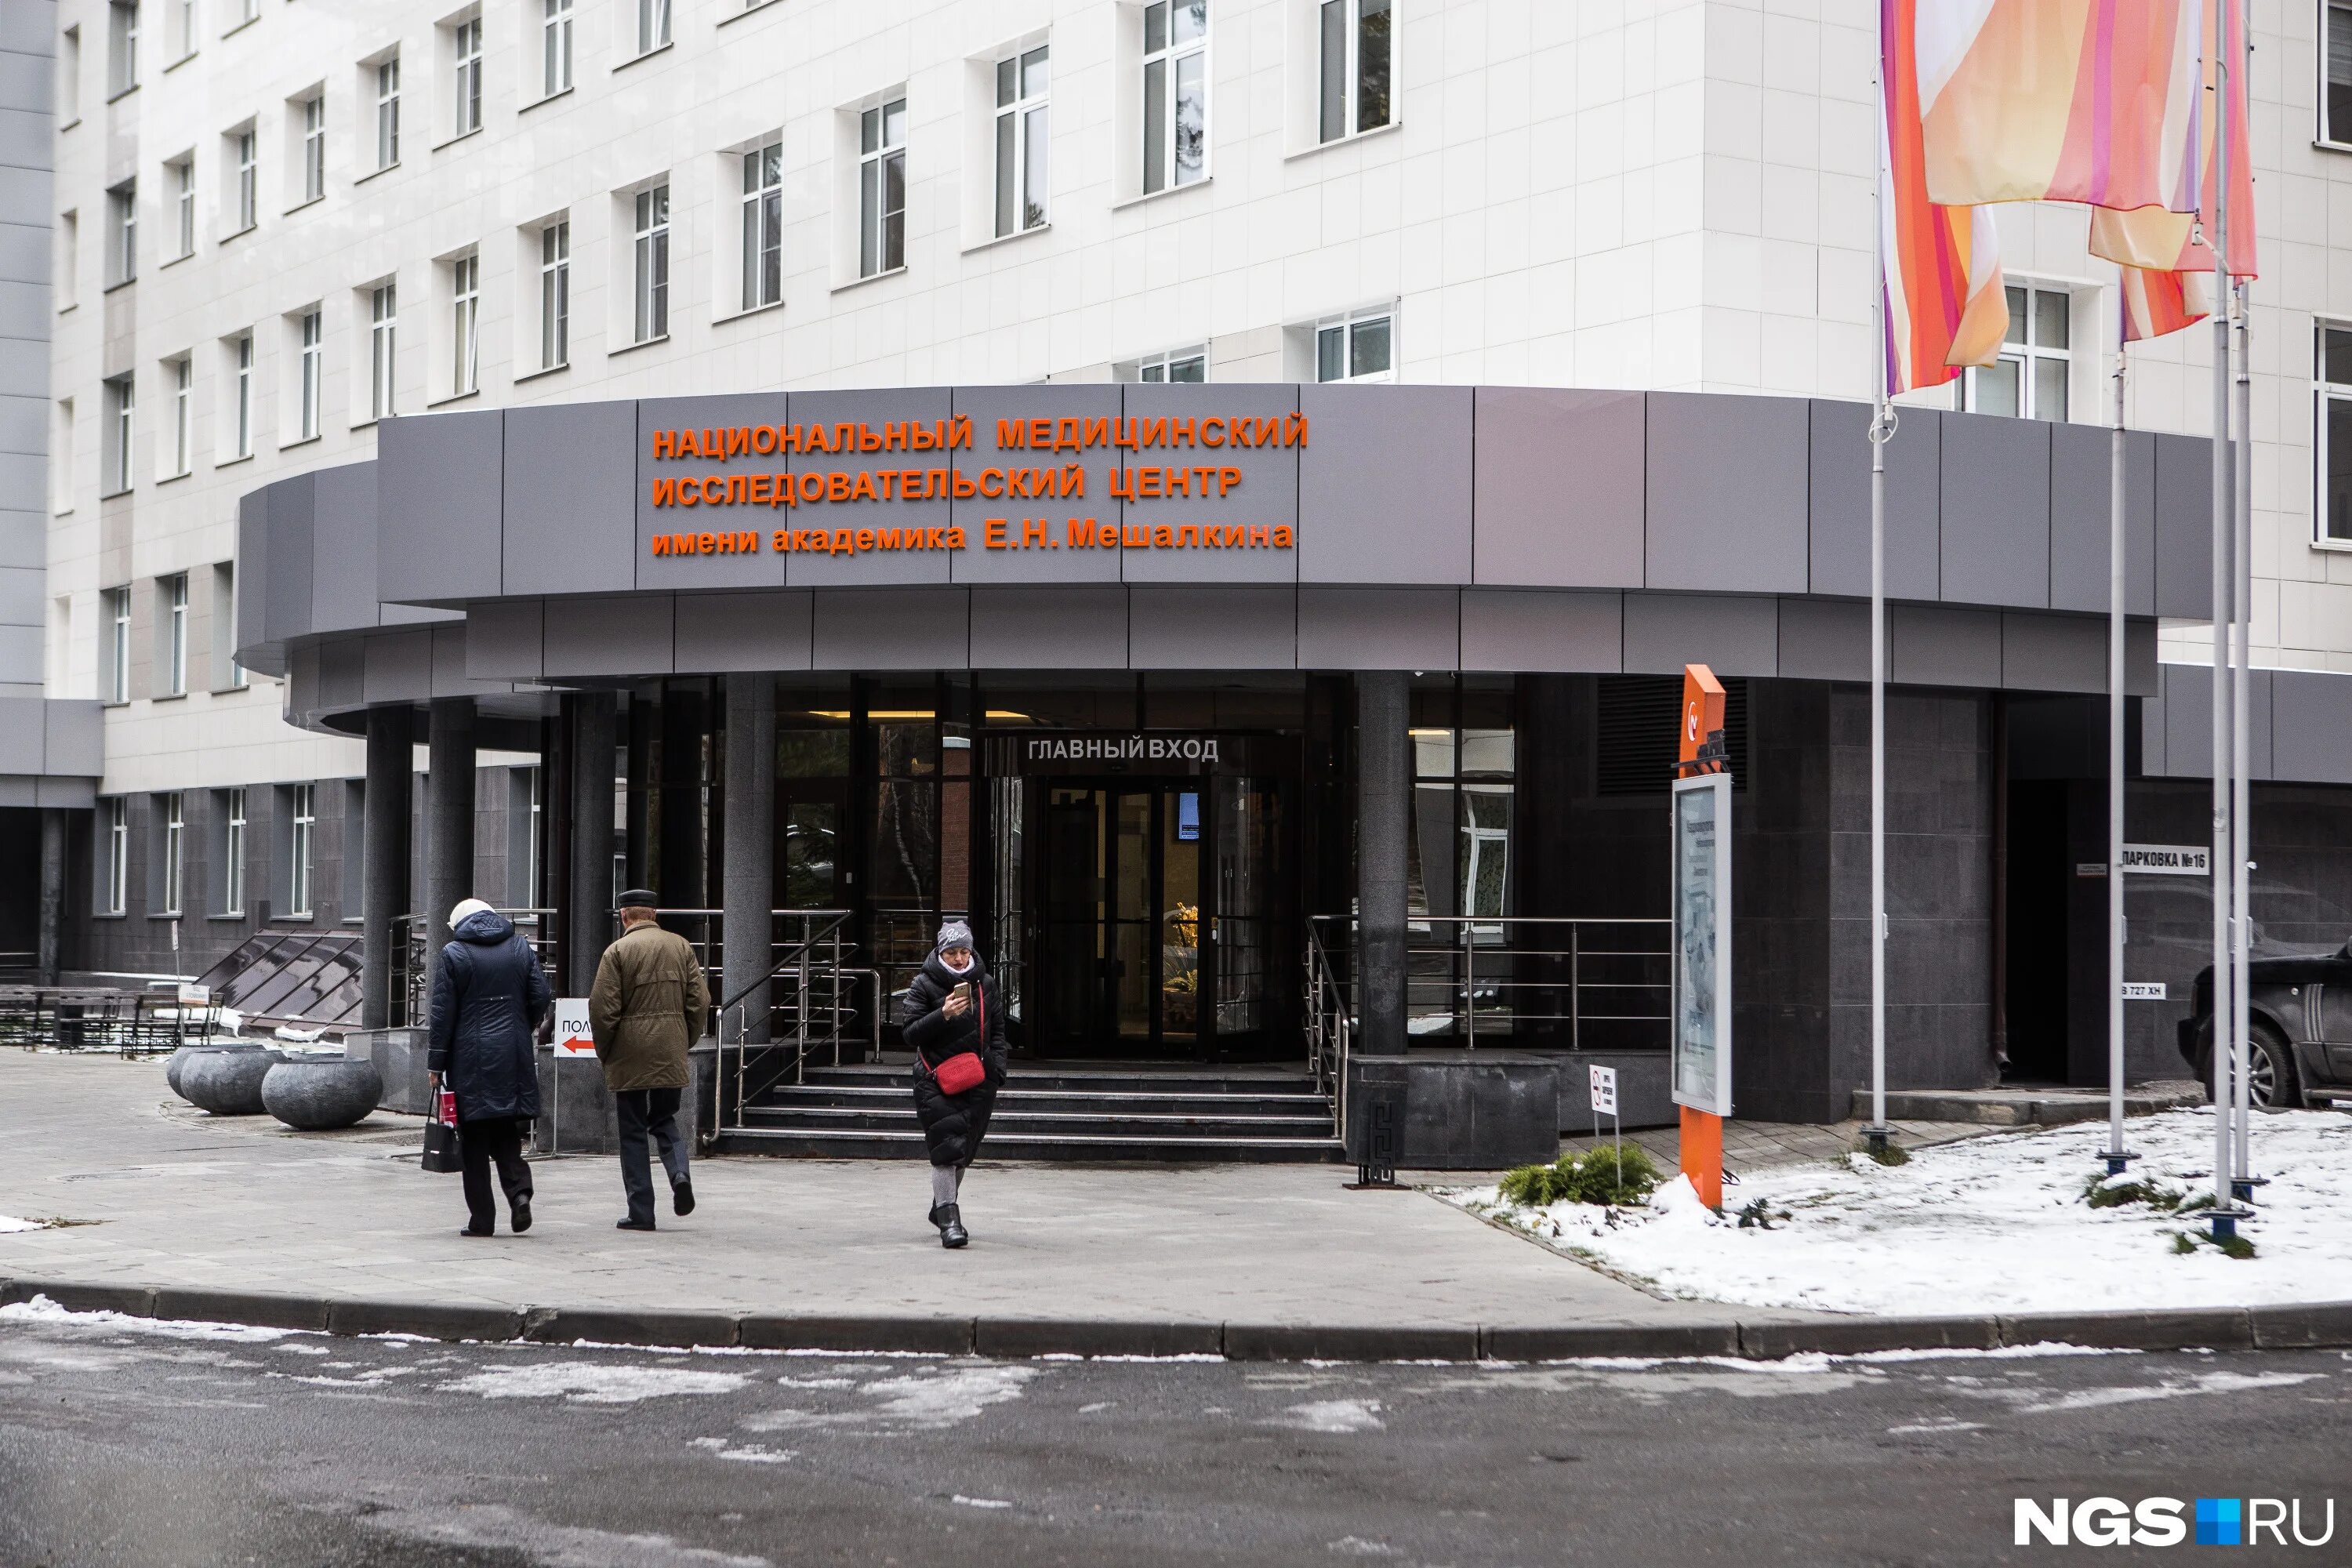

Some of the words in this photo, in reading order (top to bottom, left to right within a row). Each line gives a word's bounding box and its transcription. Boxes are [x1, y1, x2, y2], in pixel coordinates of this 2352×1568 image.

[652, 415, 974, 463] НАЦИОНАЛЬНЫЙ
[996, 412, 1309, 449] МЕДИЦИНСКИЙ
[652, 463, 1086, 509] ИССЛЕДОВАТЕЛЬСКИЙ
[1109, 466, 1242, 503] ЦЕНТР
[652, 530, 759, 556] имени
[771, 526, 967, 557] академика
[1067, 517, 1294, 548] Мешалкина
[1029, 735, 1144, 760] ГЛАВНЫЙ
[1149, 739, 1219, 763] ВХОД
[2122, 851, 2178, 867] ПАРКОВКА
[2181, 852, 2205, 868] №16
[2129, 986, 2145, 995] 727
[562, 1020, 591, 1033] ПОЛ
